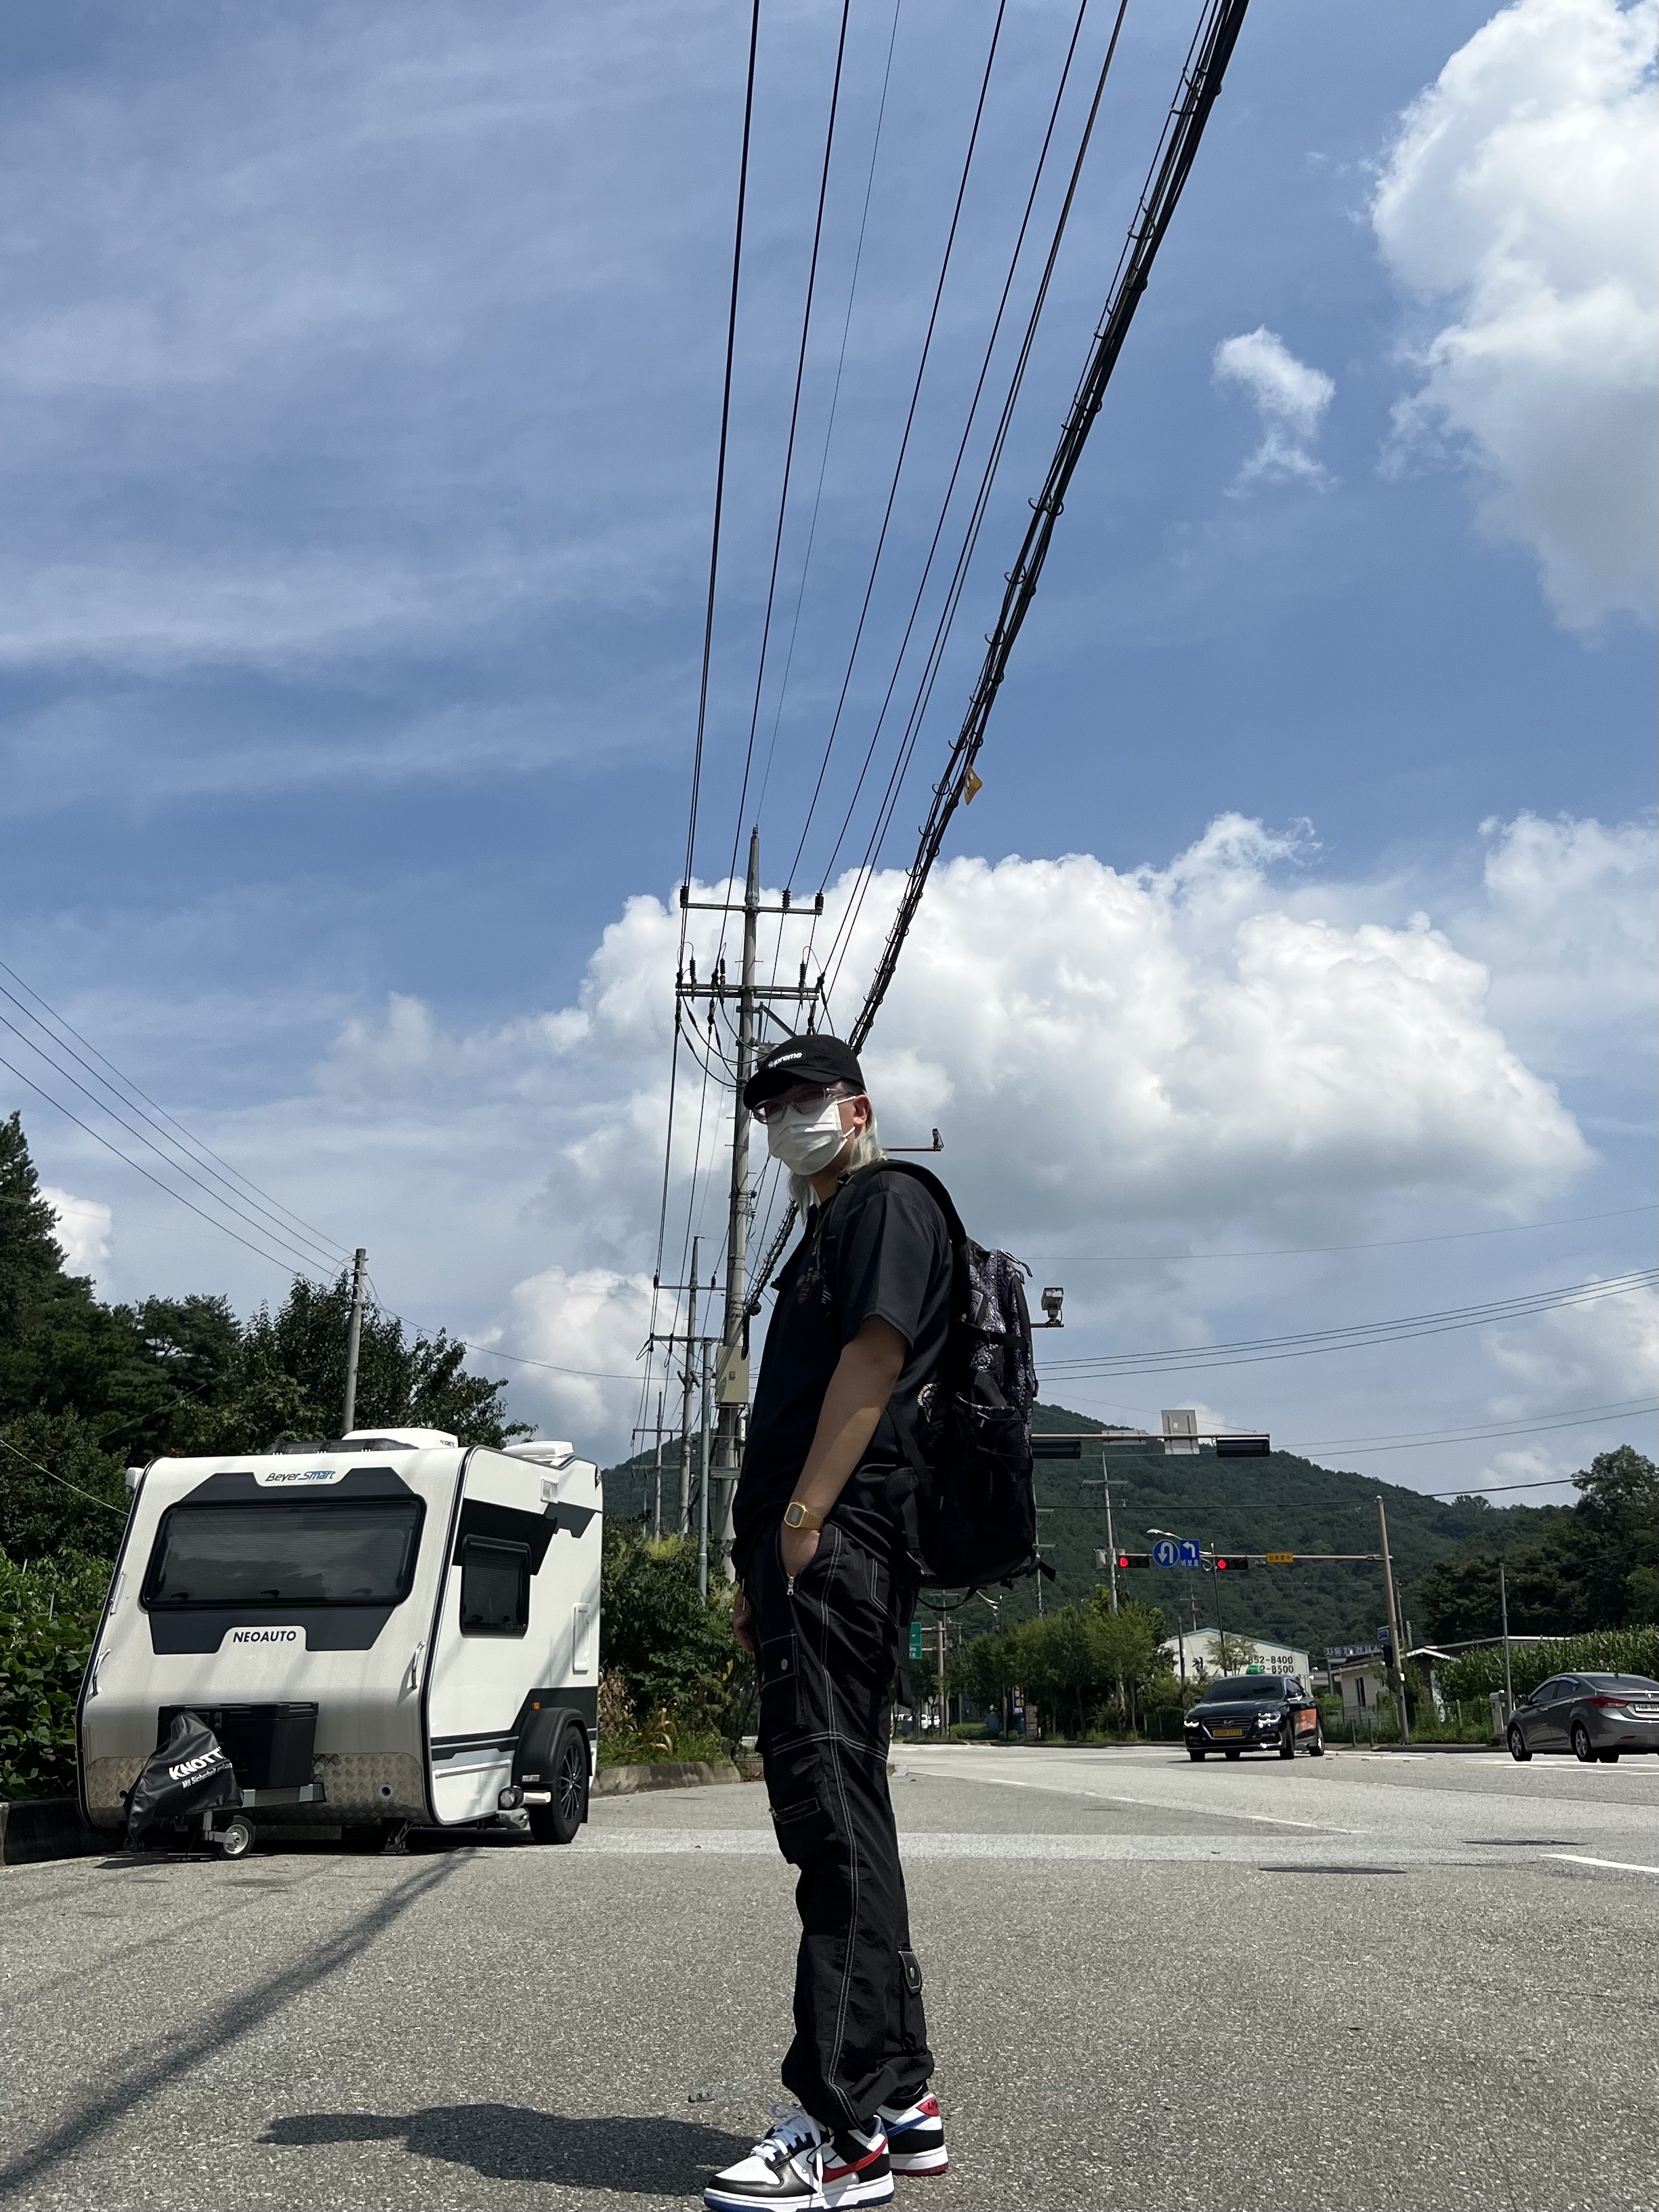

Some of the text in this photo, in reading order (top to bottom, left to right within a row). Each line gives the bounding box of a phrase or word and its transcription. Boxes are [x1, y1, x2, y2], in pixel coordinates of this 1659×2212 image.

[265, 1470, 336, 1482] Beyer Smart
[232, 1631, 297, 1642] NEOAUTO
[1248, 1656, 1293, 1664] 852-8400
